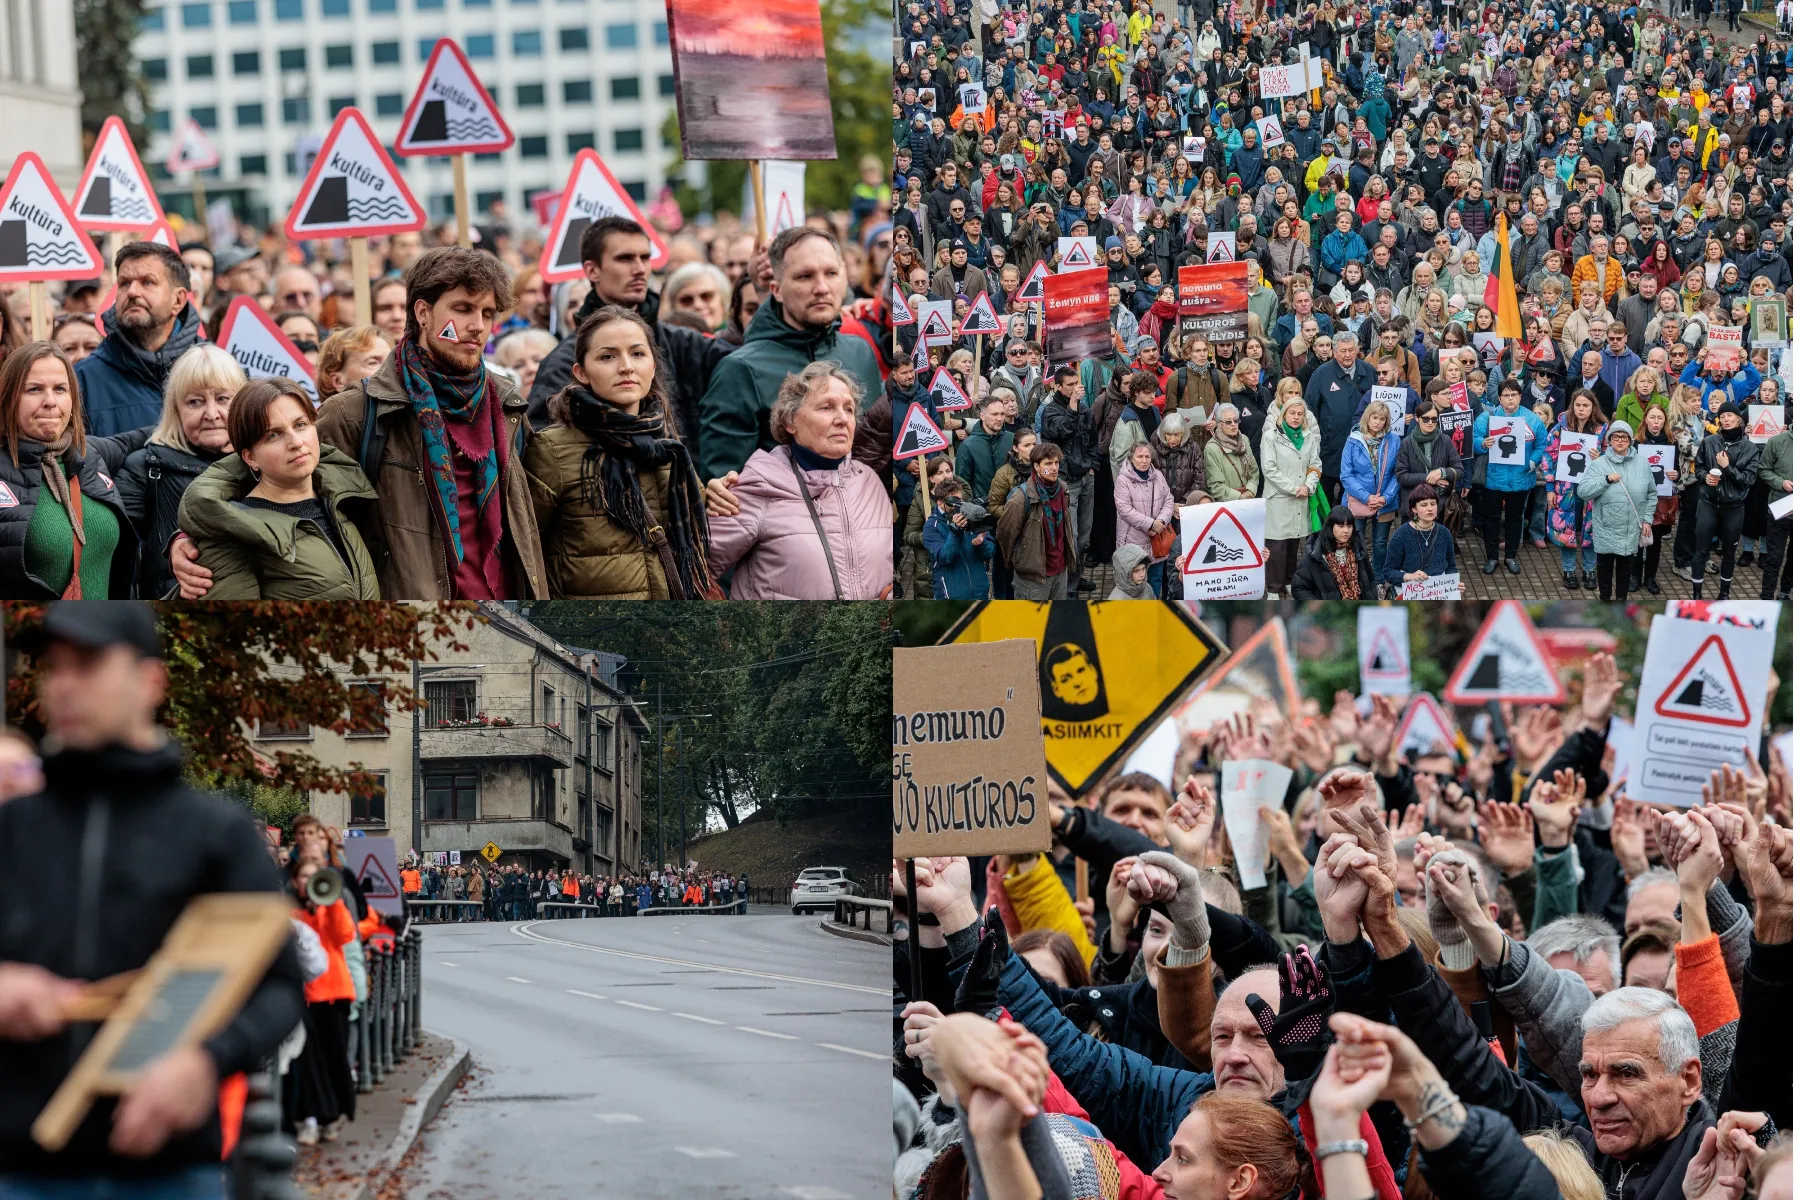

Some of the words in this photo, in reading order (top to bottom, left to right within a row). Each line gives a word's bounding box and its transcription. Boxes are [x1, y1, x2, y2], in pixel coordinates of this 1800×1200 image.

[430, 77, 478, 113] kultūra
[100, 154, 137, 194] kultūra
[330, 151, 385, 192] kultūra
[574, 191, 614, 218] kultū
[9, 194, 63, 237] kultūra
[1181, 283, 1223, 294] nemuno
[1049, 298, 1081, 309] žemyn
[1083, 293, 1100, 305] upe
[1181, 295, 1211, 306] aušra
[1182, 318, 1236, 330] KULTŪROS
[1709, 331, 1741, 341] BASTA
[231, 343, 290, 377] kultūra
[935, 381, 957, 396] kultūra
[1375, 390, 1402, 400] LIŪDNI
[908, 420, 932, 435] kultūra
[1195, 578, 1222, 588] MANO
[1226, 573, 1249, 584] JŪRA
[1043, 723, 1124, 739] ASIIMKIT
[924, 775, 1036, 834] KULTŪROS
